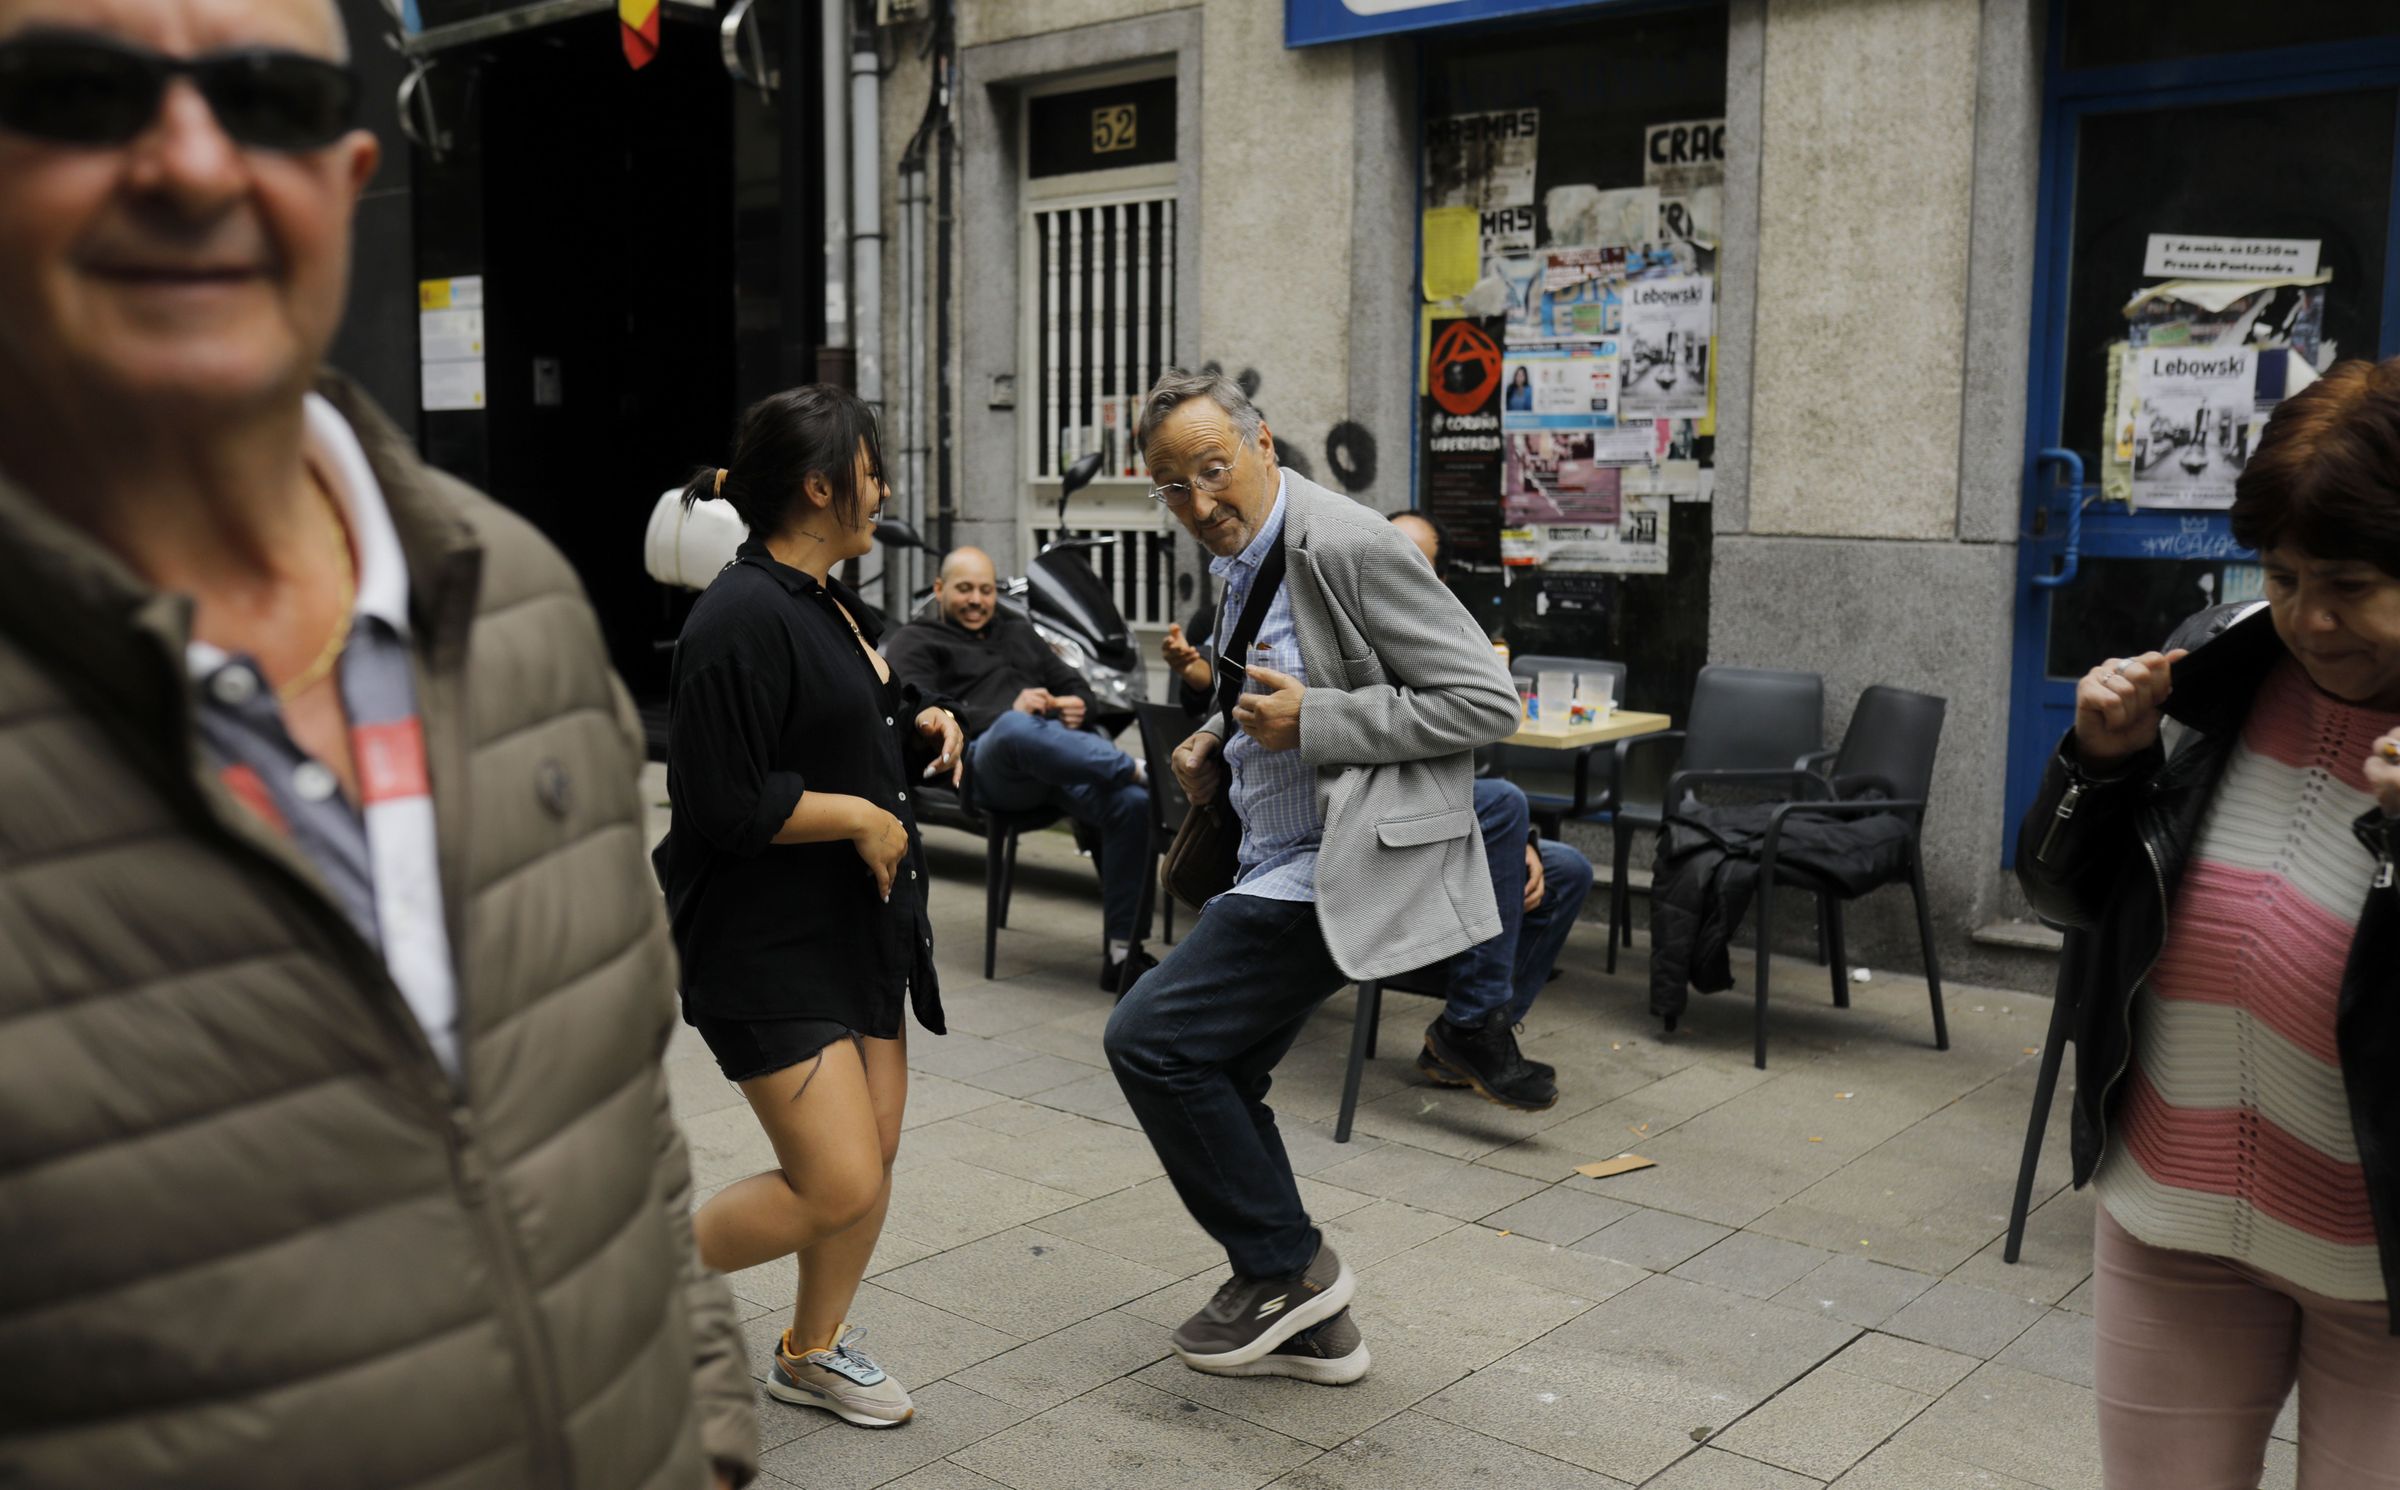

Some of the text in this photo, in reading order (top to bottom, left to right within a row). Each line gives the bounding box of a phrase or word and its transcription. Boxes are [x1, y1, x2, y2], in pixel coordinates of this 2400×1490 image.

[1096, 109, 1132, 147] 52
[2203, 260, 2217, 271] de
[1633, 285, 1703, 306] Lebowski
[2153, 355, 2244, 377] Lebowski
